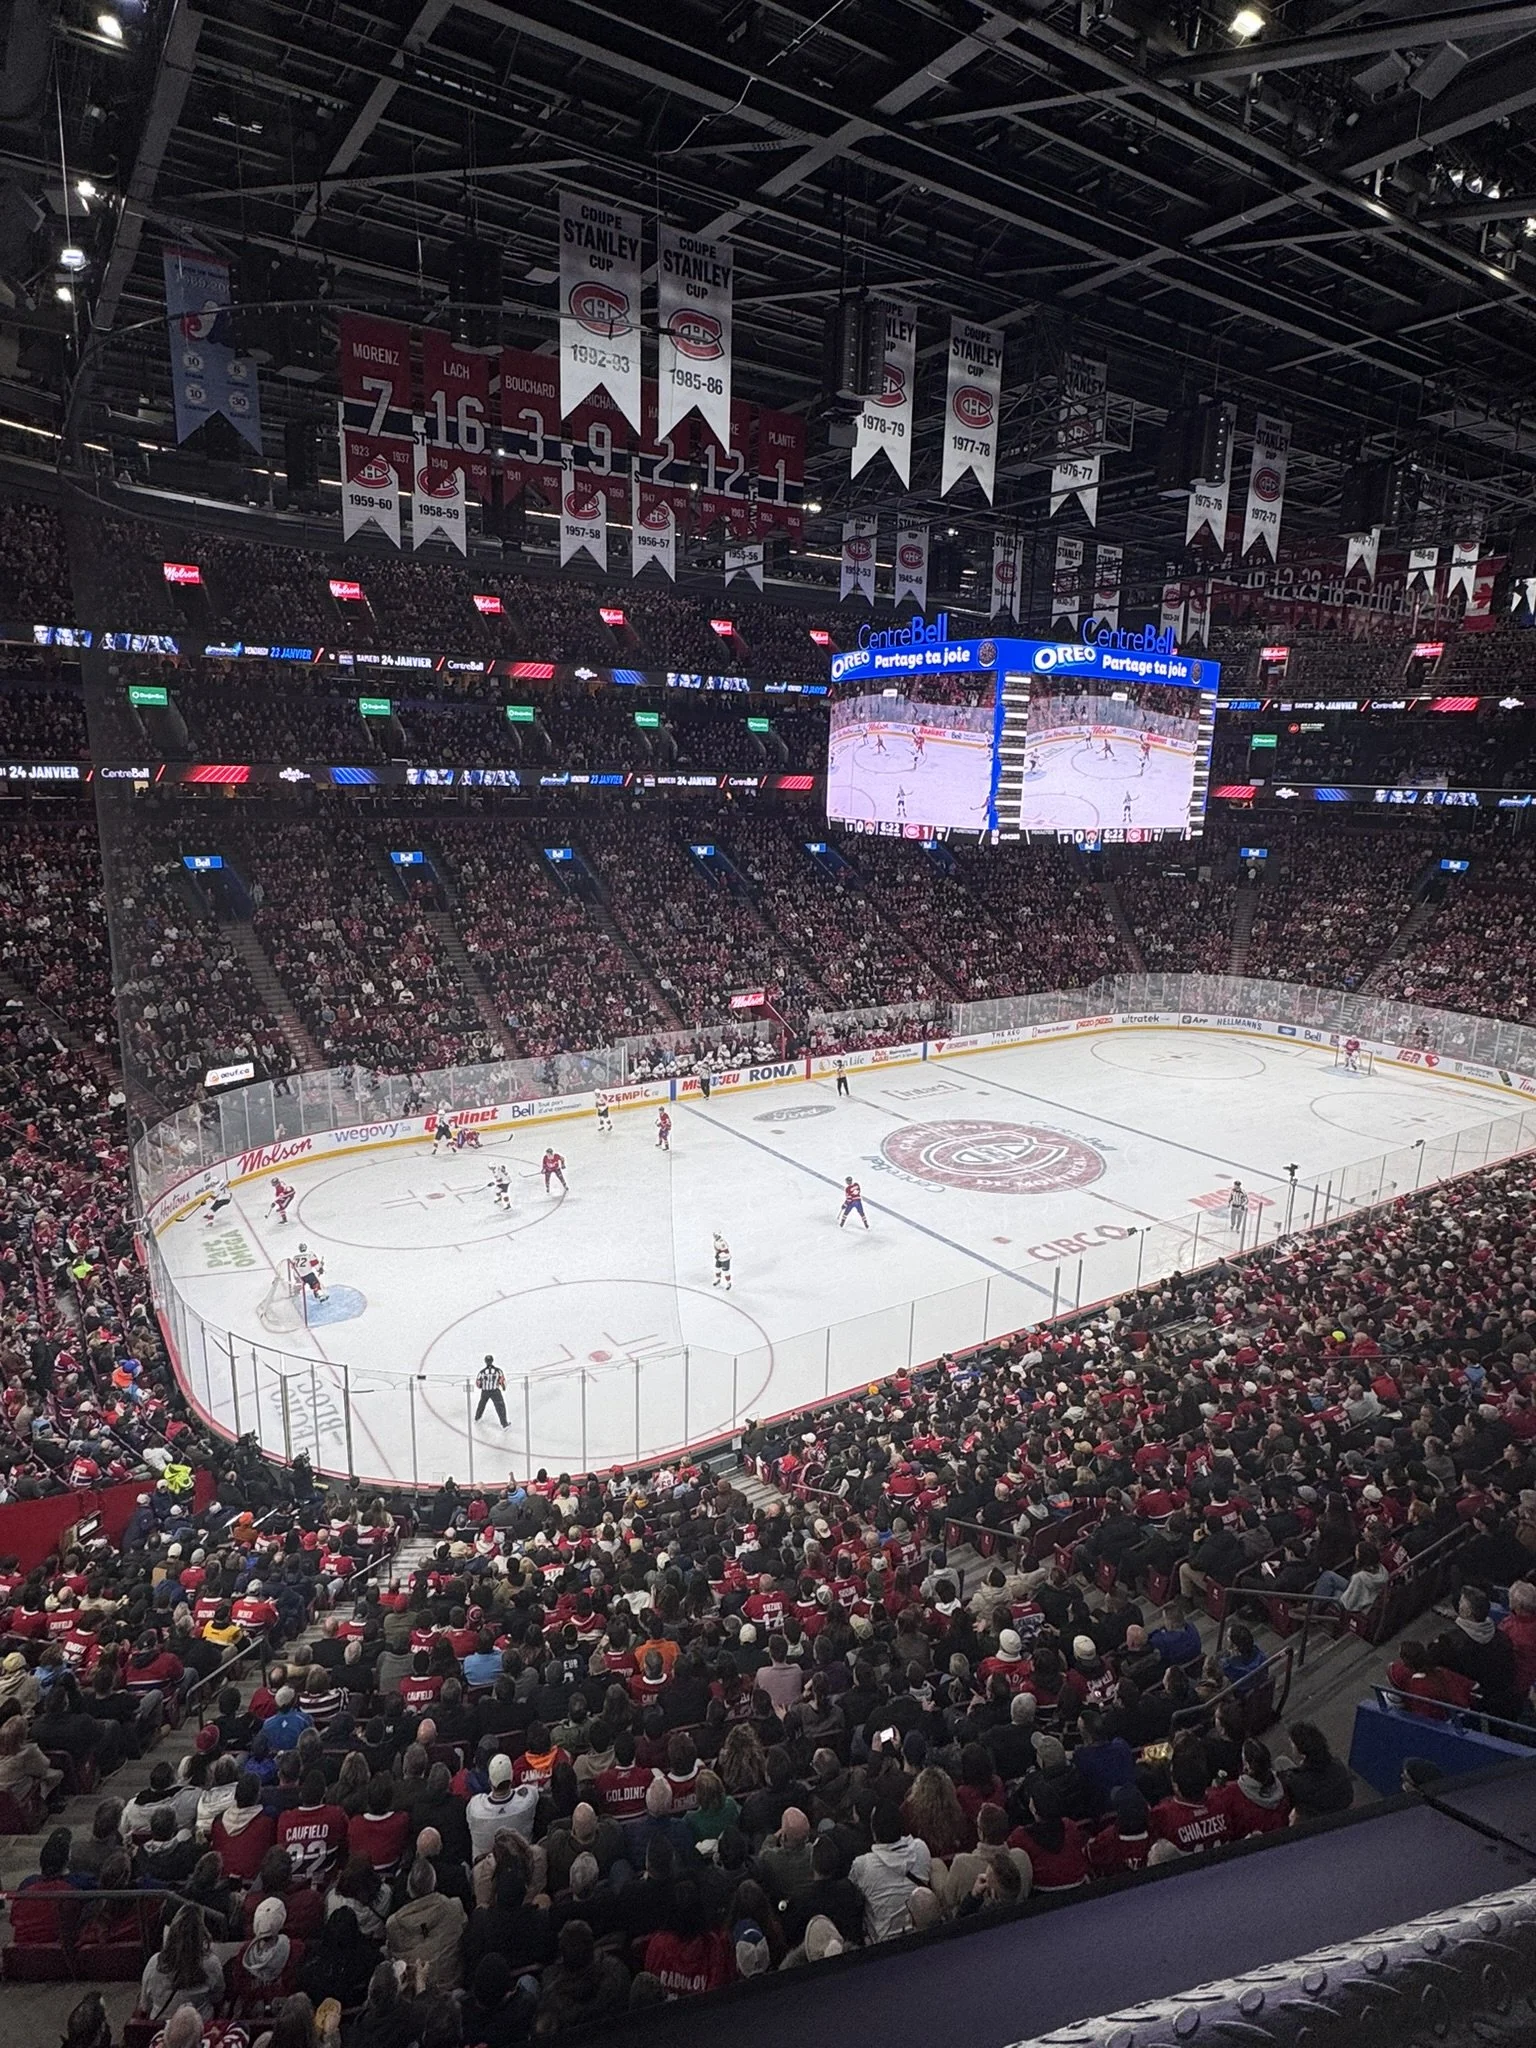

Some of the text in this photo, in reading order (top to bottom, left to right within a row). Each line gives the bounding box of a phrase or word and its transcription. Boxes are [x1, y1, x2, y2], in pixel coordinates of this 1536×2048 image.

[581, 204, 623, 230] COUPE
[563, 218, 640, 262] STANLEY
[679, 236, 717, 260] COUPE
[589, 254, 614, 273] CUP
[663, 249, 733, 290] STANLEY
[686, 282, 709, 300] CUP
[964, 325, 992, 344] COUPE
[352, 342, 401, 367] MORENZ
[570, 343, 631, 375] 1992-93
[952, 337, 1003, 369] STANLEY
[443, 360, 471, 380] LACH
[966, 364, 984, 378] CUP
[505, 374, 556, 399] BOUCHARD
[669, 368, 724, 396] 1985-86
[362, 375, 393, 437] 7
[430, 389, 486, 455] 16
[861, 414, 905, 438] 1978-79
[518, 407, 546, 465] 3
[768, 430, 797, 449] PLANTE
[1256, 430, 1290, 452] STANLEY
[350, 444, 371, 458] 1923
[588, 422, 612, 477] 9
[952, 435, 991, 457] 1977-78
[392, 450, 410, 464] 1937
[431, 456, 449, 470] 1940
[652, 436, 676, 489] 2
[471, 463, 488, 478] 1954
[506, 469, 522, 483] 1941
[703, 444, 745, 500] 12
[1058, 464, 1093, 481] 1976-77
[542, 476, 560, 489] 1956
[774, 458, 788, 508] 1
[608, 486, 625, 499] 1960
[349, 494, 393, 511] 1959-60
[673, 497, 688, 510] 1961
[702, 500, 717, 515] 1951
[1194, 494, 1223, 511] 1975-76
[418, 503, 460, 520] 1958-59
[1251, 508, 1277, 525] 1972-73
[565, 525, 601, 540] 1957-58
[637, 535, 671, 549] 1956-57
[1057, 547, 1082, 561] STANLEY
[165, 566, 200, 581] Molson
[898, 573, 924, 585] 1945-46
[331, 582, 360, 598] Molson
[857, 612, 949, 651] CentreBell
[1082, 618, 1174, 655] CentreBell
[270, 646, 280, 658] 23
[281, 647, 313, 660] JANVIER
[381, 655, 394, 666] 24
[395, 656, 432, 668] JANVIER
[447, 660, 484, 671] CentreBell
[832, 646, 971, 679] OREO Partage ta joie
[1034, 646, 1188, 679] OREO Partage ta joie
[1314, 702, 1325, 711] 24
[1325, 702, 1357, 711] JANVIER
[1371, 702, 1406, 711] CentreBell
[9, 766, 79, 780] 24 JANVIER
[101, 767, 150, 779] CentreBell
[590, 774, 624, 786] 23 JANVIER
[677, 776, 687, 786] 24
[687, 776, 718, 787] JANVIER
[728, 777, 758, 787] CentreBell
[857, 820, 864, 832] 0
[880, 823, 900, 834] 6:22
[923, 826, 929, 839] 1
[1075, 830, 1084, 844] 0
[1104, 830, 1124, 840] 6:22
[1143, 830, 1149, 842] 1
[195, 857, 211, 868] Bell
[400, 853, 414, 864] Bell
[1121, 1014, 1160, 1024] ultratek
[992, 1030, 1005, 1038] THE
[1304, 1029, 1322, 1042] Bell
[749, 1063, 797, 1082] RONA
[511, 1102, 535, 1120] Bell
[334, 1121, 400, 1143] wegovy
[236, 1137, 313, 1175] Molson
[1027, 1230, 1101, 1262] CIBC
[606, 1785, 646, 1803] GOLDING
[286, 1823, 329, 1842] CAUFIELD
[660, 1969, 709, 1993] RADULOV
